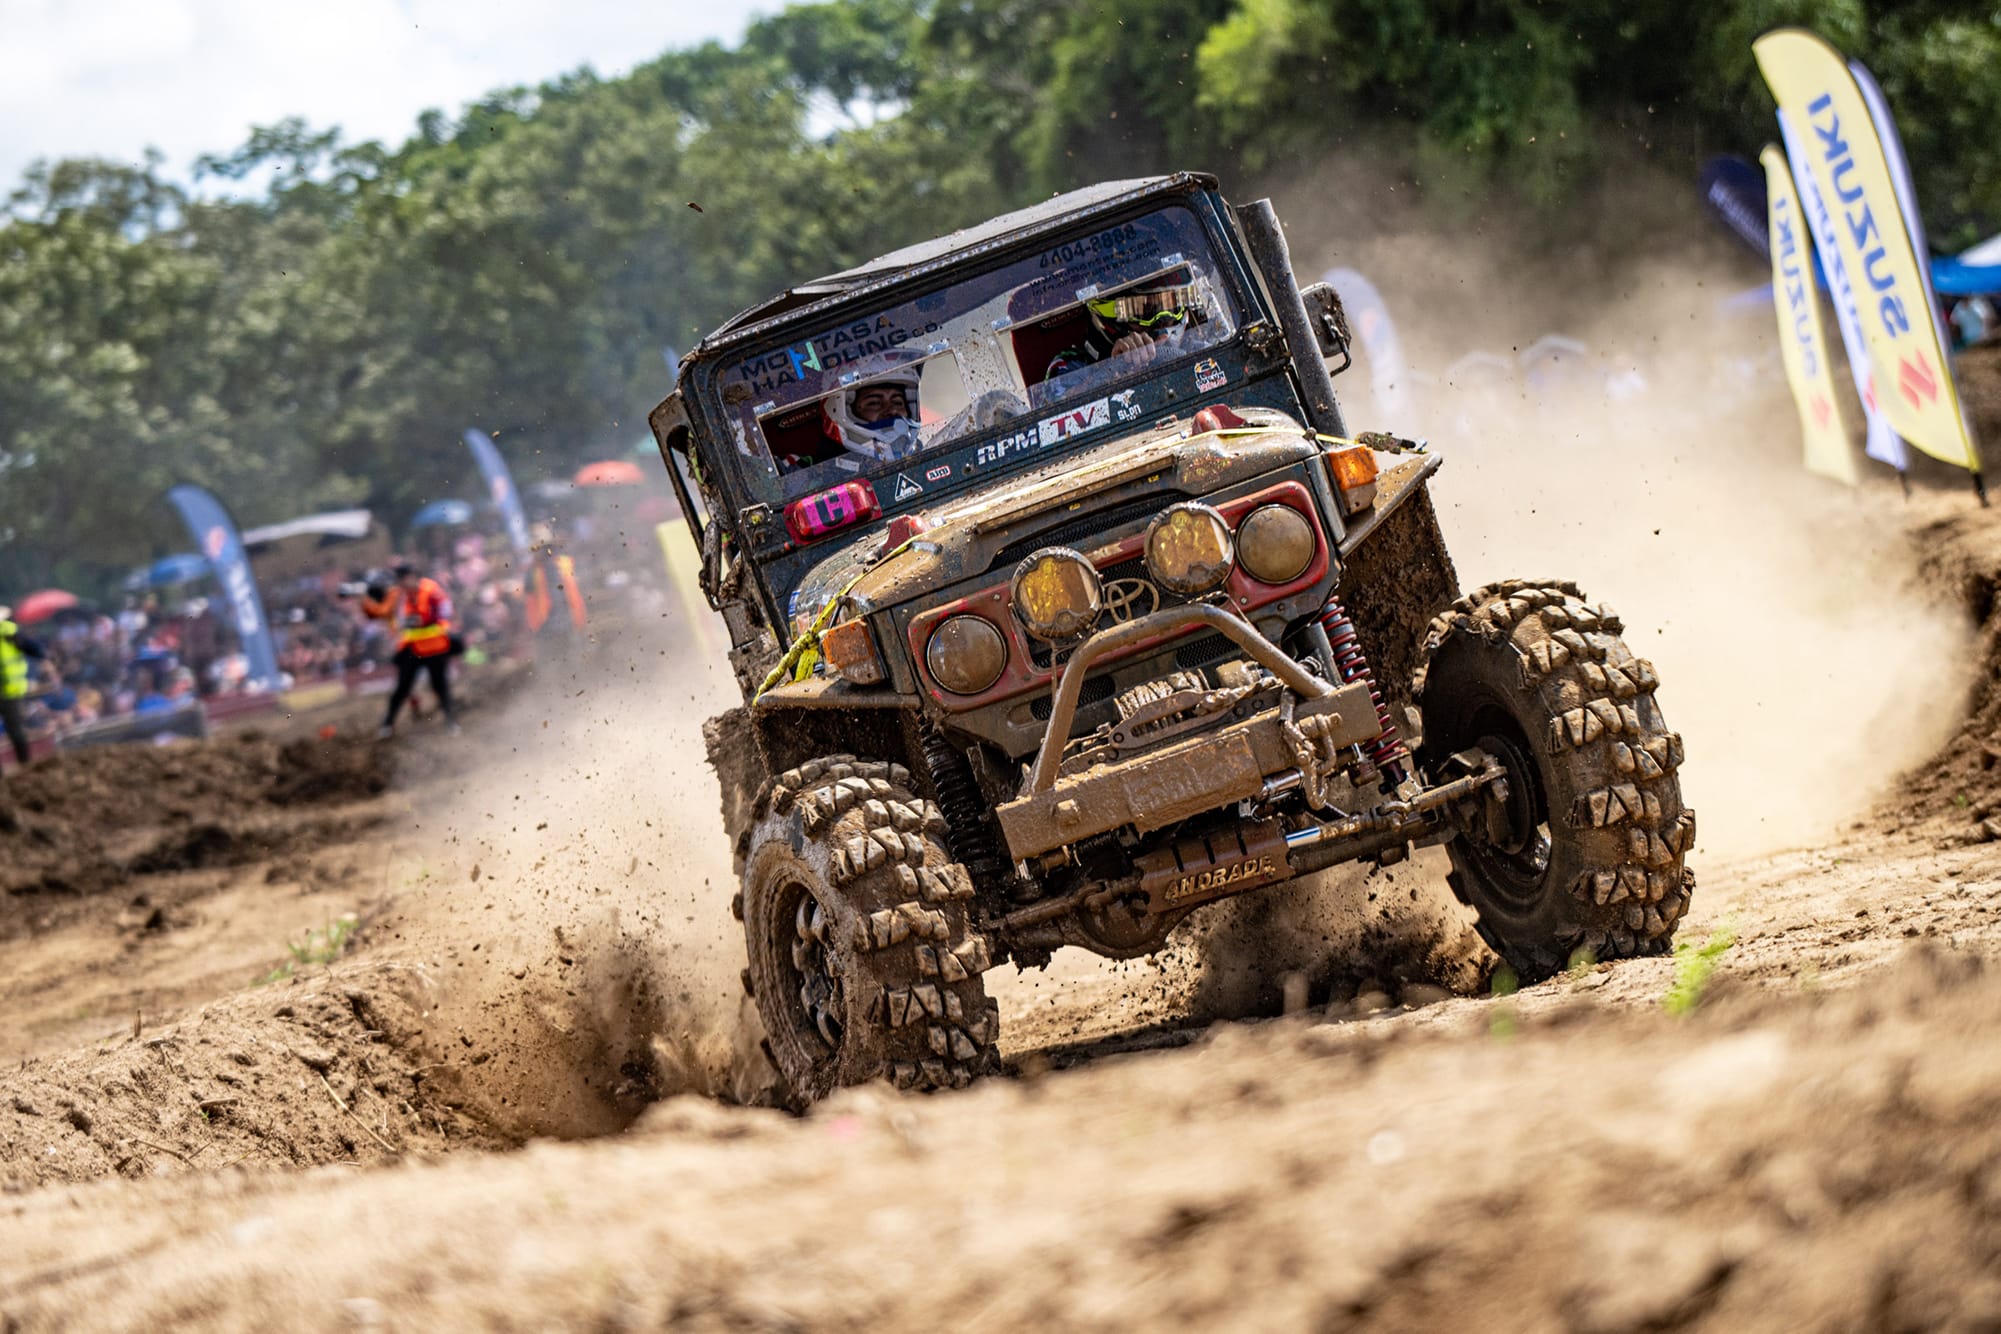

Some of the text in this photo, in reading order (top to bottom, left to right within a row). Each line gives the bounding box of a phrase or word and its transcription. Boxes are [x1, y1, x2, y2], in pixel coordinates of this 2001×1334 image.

[977, 406, 1096, 465] RPM TV
[814, 491, 845, 527] C
[1164, 855, 1275, 900] ANDRADE
